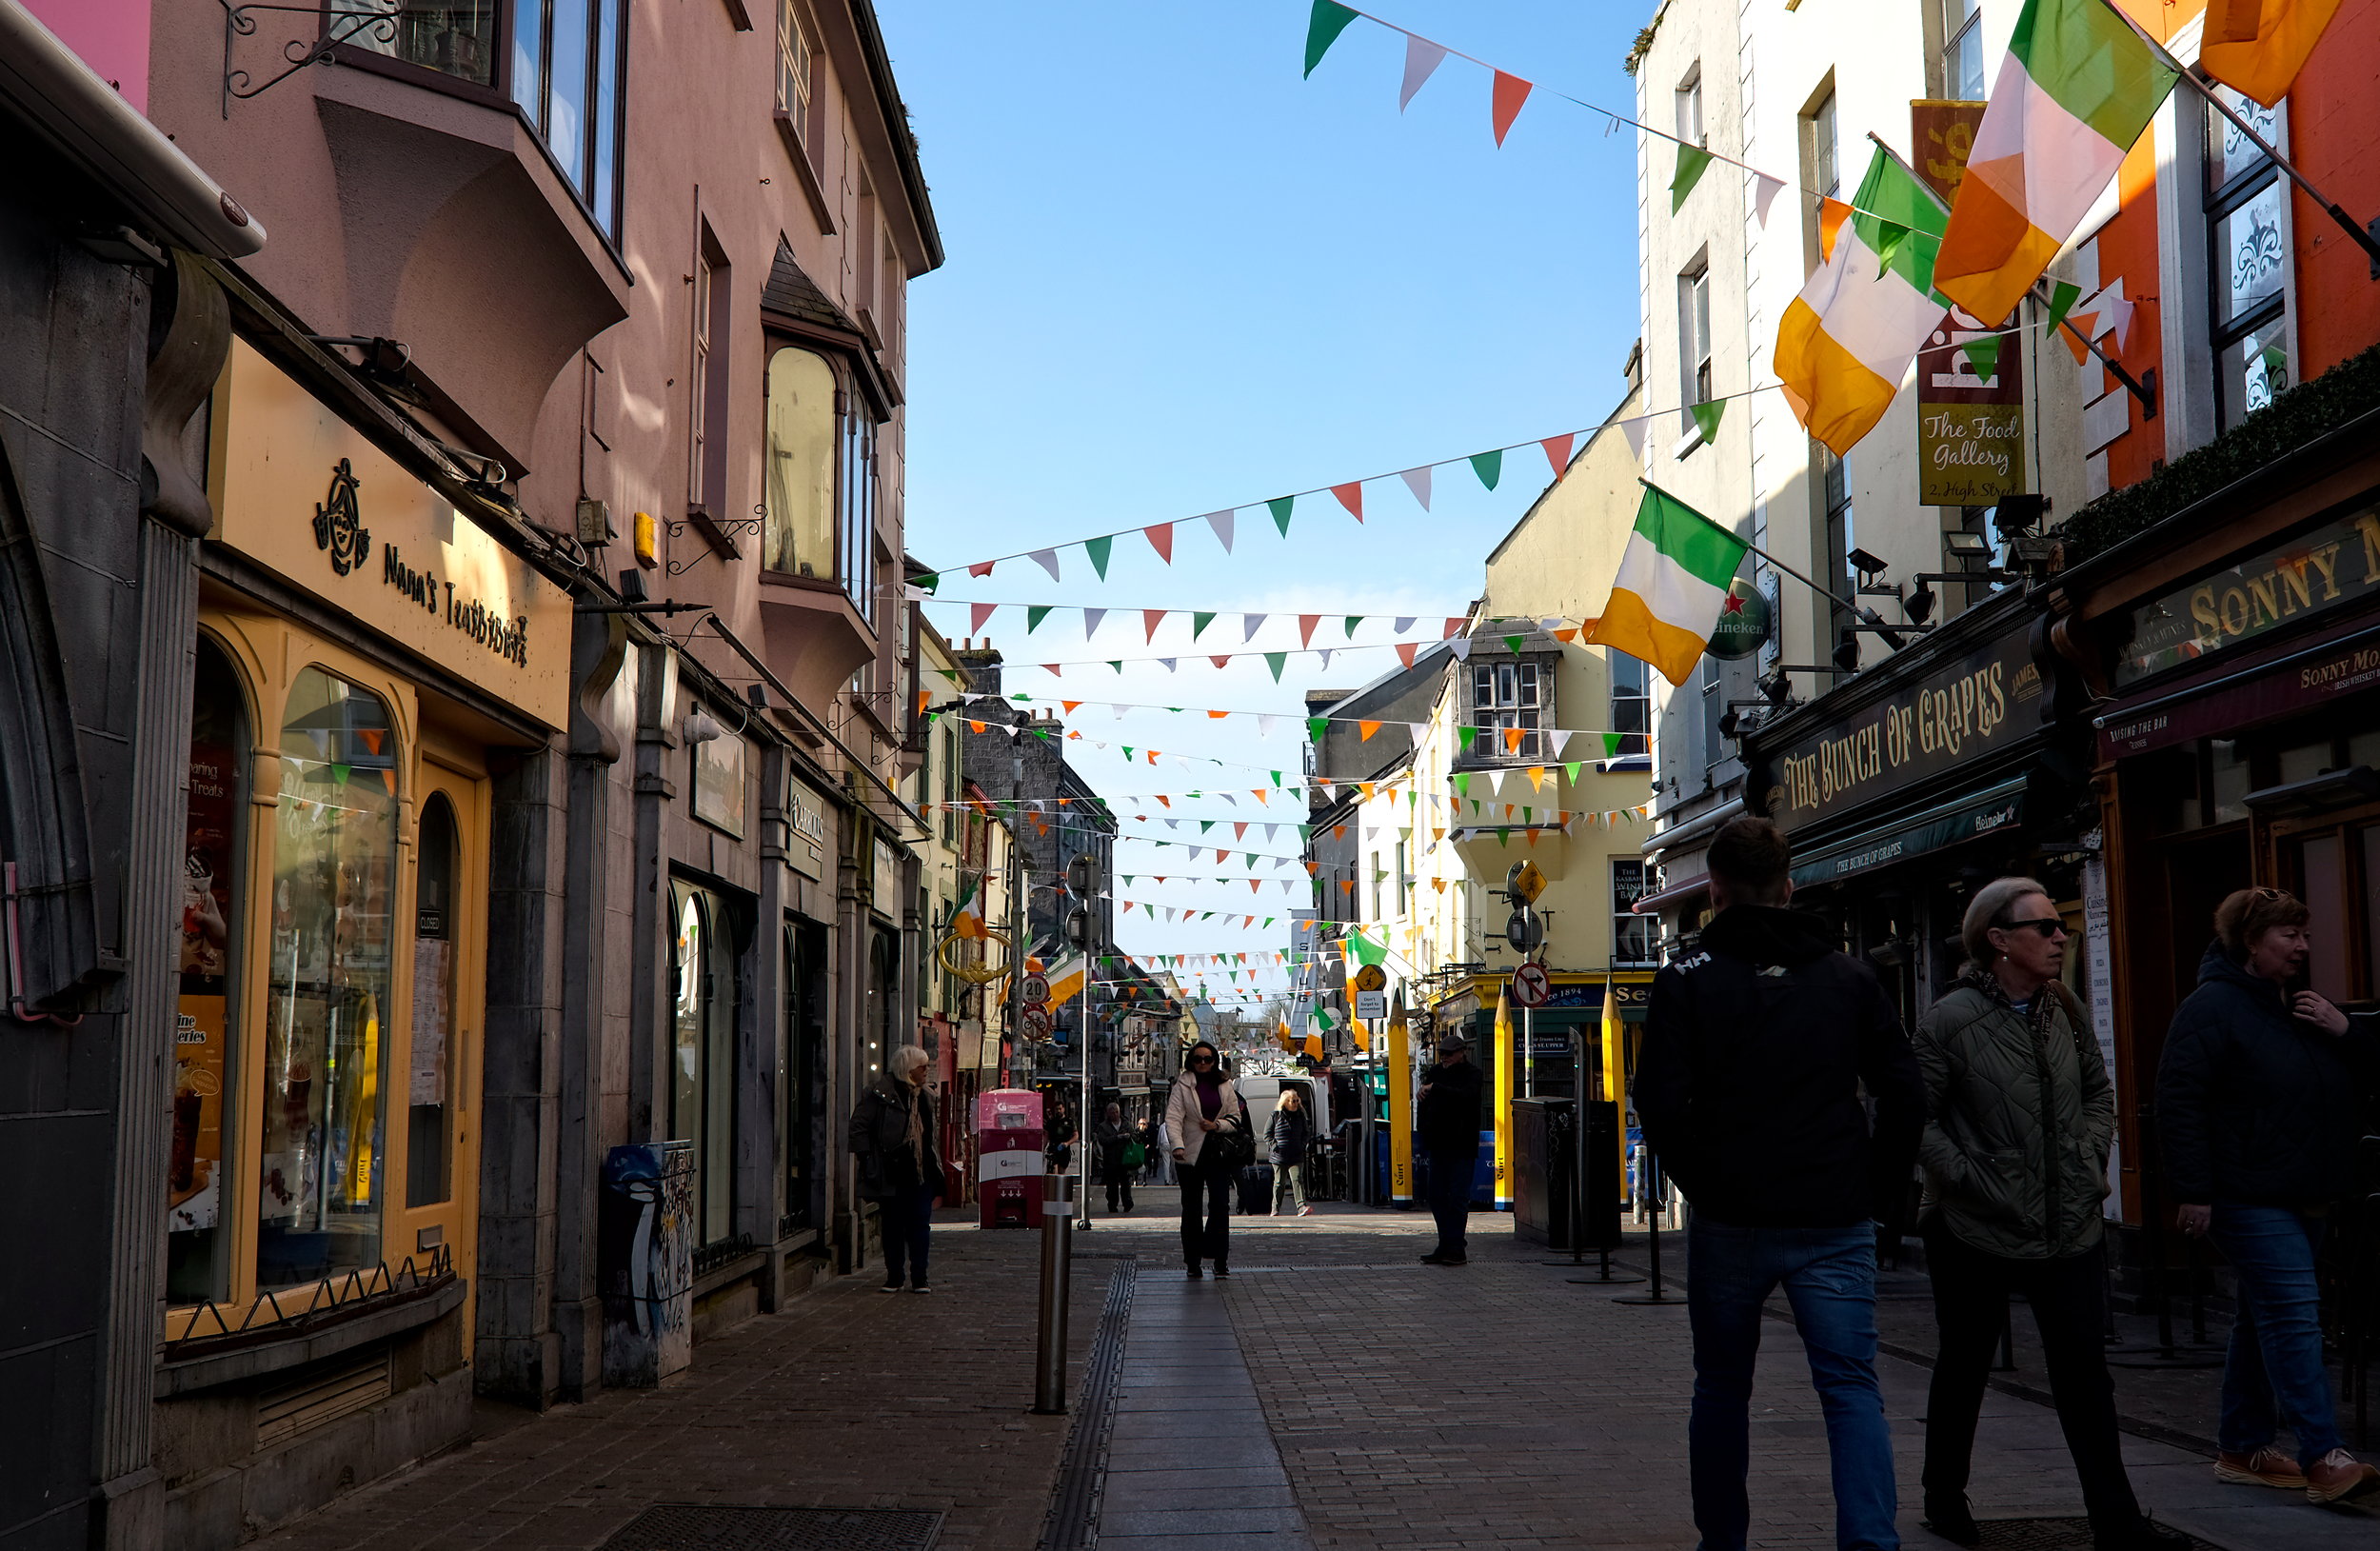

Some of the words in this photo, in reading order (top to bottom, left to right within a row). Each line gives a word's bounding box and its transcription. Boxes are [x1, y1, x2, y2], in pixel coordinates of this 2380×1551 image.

[1924, 411, 1967, 438] The
[1972, 415, 2020, 439] Food
[1934, 440, 2010, 476] Gallery
[1929, 484, 1940, 496] 2,
[1943, 480, 1977, 502] High
[384, 543, 437, 614] Nana's
[2191, 542, 2341, 646] SONNY
[2012, 663, 2040, 697] JAMES
[2300, 659, 2350, 689] SONNY
[2351, 649, 2380, 673] MO
[2350, 669, 2376, 685] WHISKEY
[1784, 752, 1819, 811] THE
[1819, 722, 1882, 803] BUNCH
[1886, 704, 1913, 767] OF
[1918, 660, 2005, 756] GRAPES
[2138, 720, 2152, 735] THE
[2153, 716, 2168, 730] BAR
[190, 779, 225, 798] Treats
[1975, 811, 2006, 831] Heinek
[1836, 859, 1849, 873] THE
[1850, 852, 1870, 870] BUNCH
[1870, 849, 1878, 864] OF
[1878, 841, 1902, 861] GRAPES
[420, 917, 440, 929] CLOSED
[1299, 942, 1308, 1003] SUG
[1026, 982, 1041, 996] 20
[1559, 986, 1581, 999] 1894
[177, 1028, 207, 1044] eries
